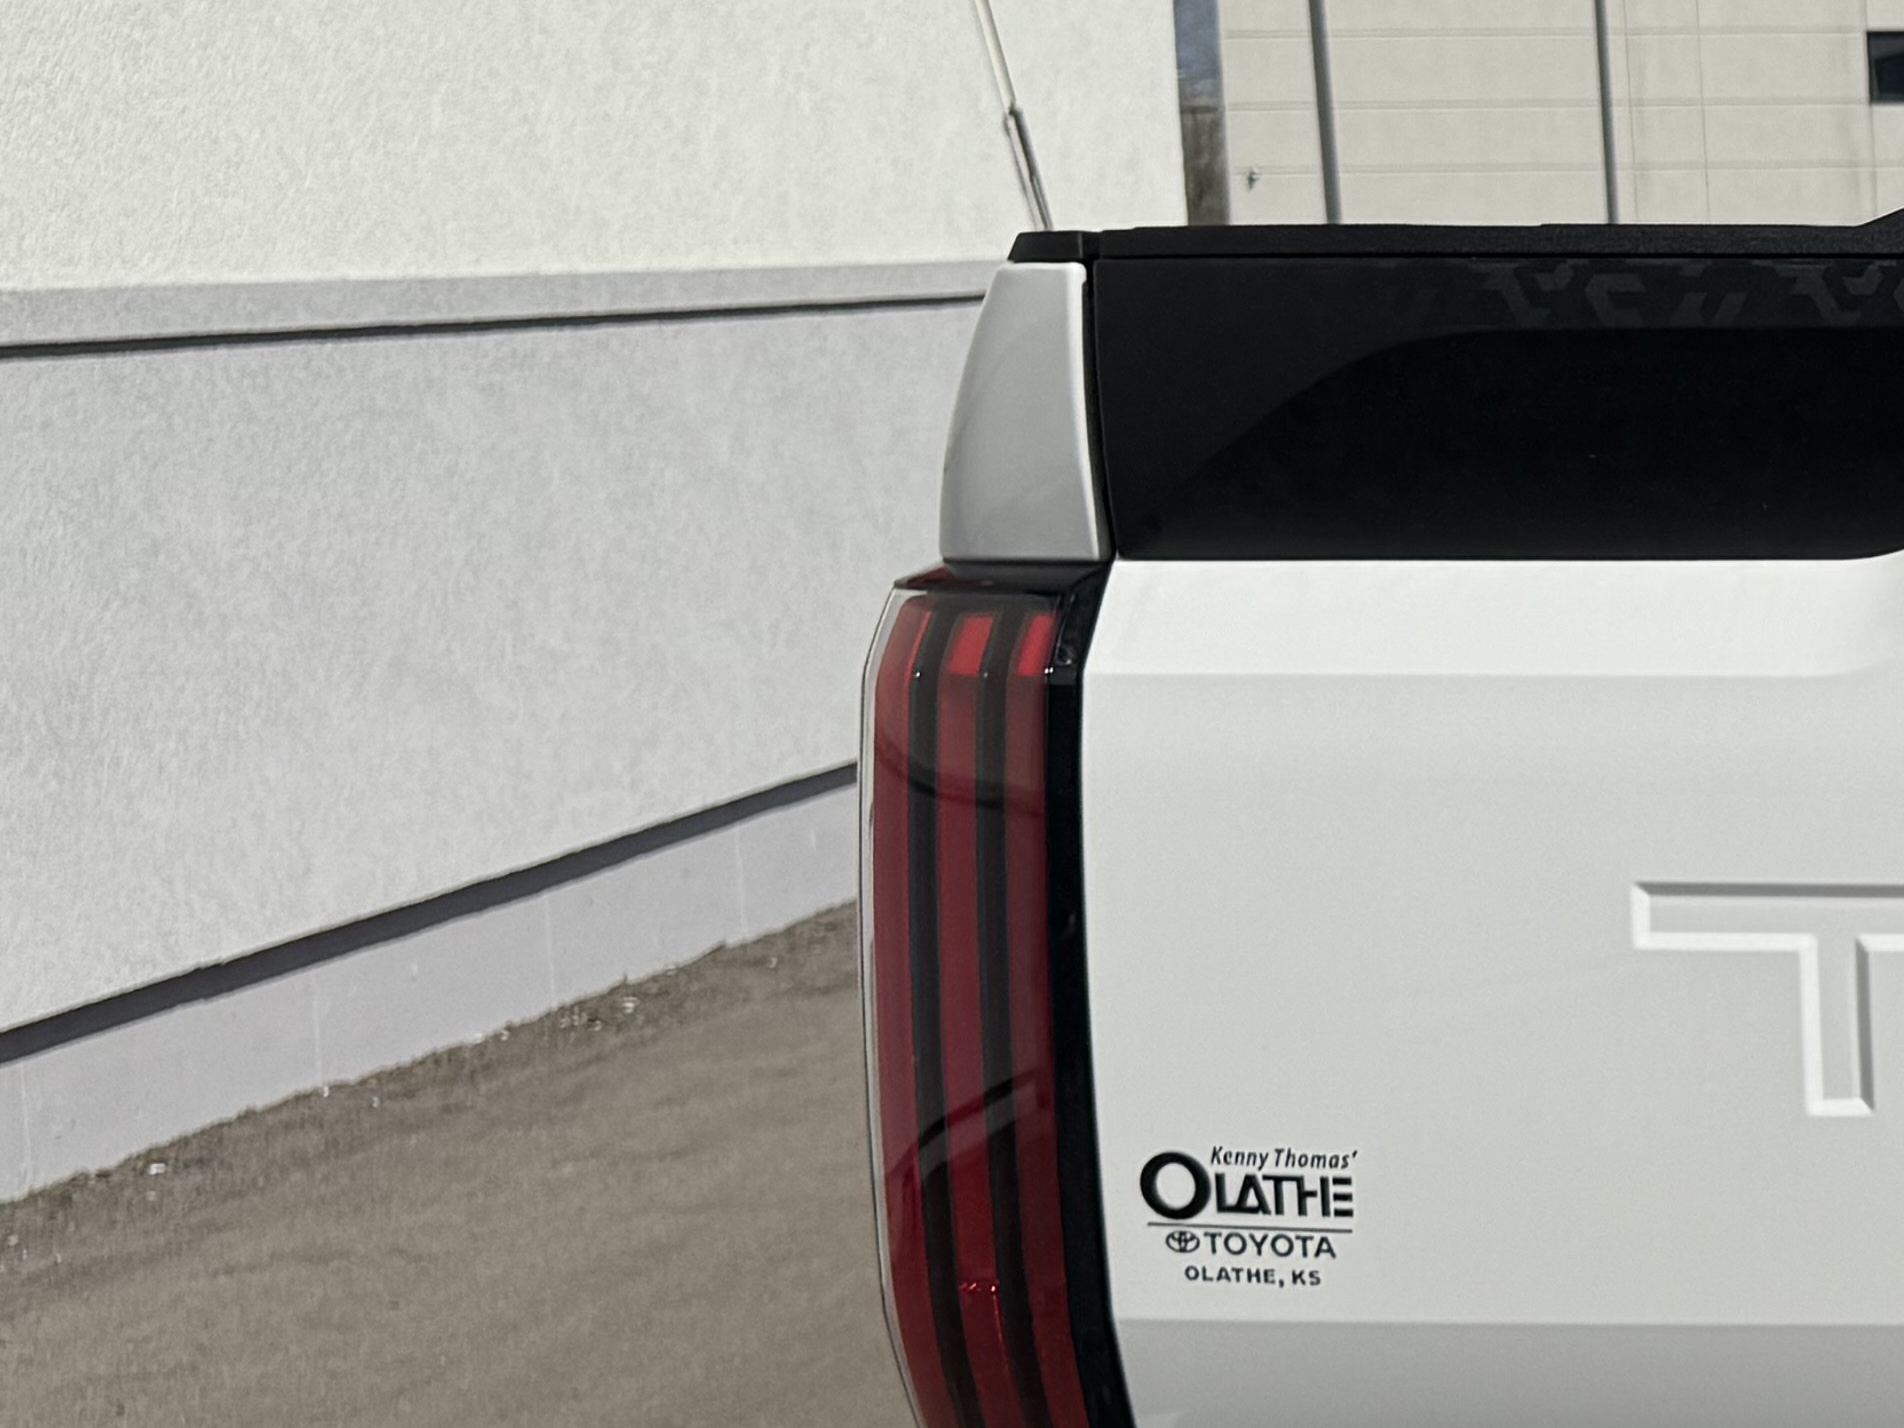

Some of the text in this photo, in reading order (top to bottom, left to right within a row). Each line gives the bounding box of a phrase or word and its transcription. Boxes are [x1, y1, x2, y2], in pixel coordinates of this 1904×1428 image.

[1210, 1145, 1358, 1171] Kenny Thomas'
[1139, 1151, 1355, 1220] OLATHE
[1203, 1231, 1337, 1259] TOYOTA
[1184, 1265, 1322, 1288] OLATHE, KS
